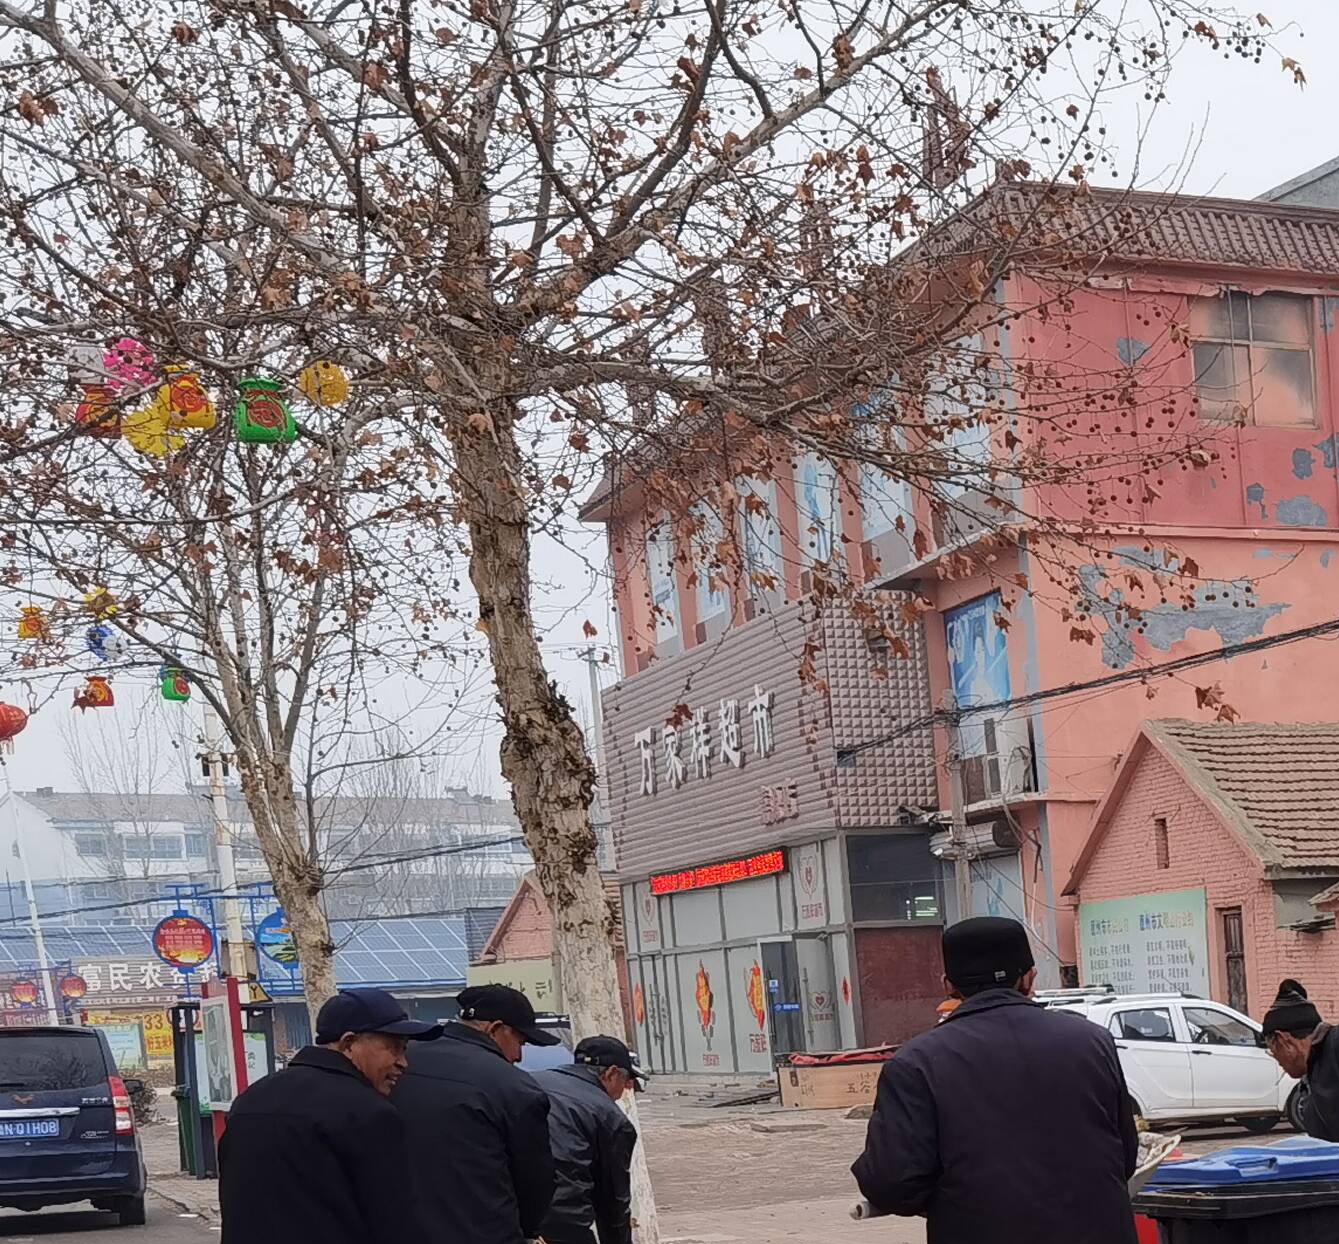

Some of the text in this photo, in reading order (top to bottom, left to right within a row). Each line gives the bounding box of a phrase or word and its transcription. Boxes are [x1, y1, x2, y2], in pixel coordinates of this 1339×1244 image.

[634, 684, 775, 796] 万家祥超市
